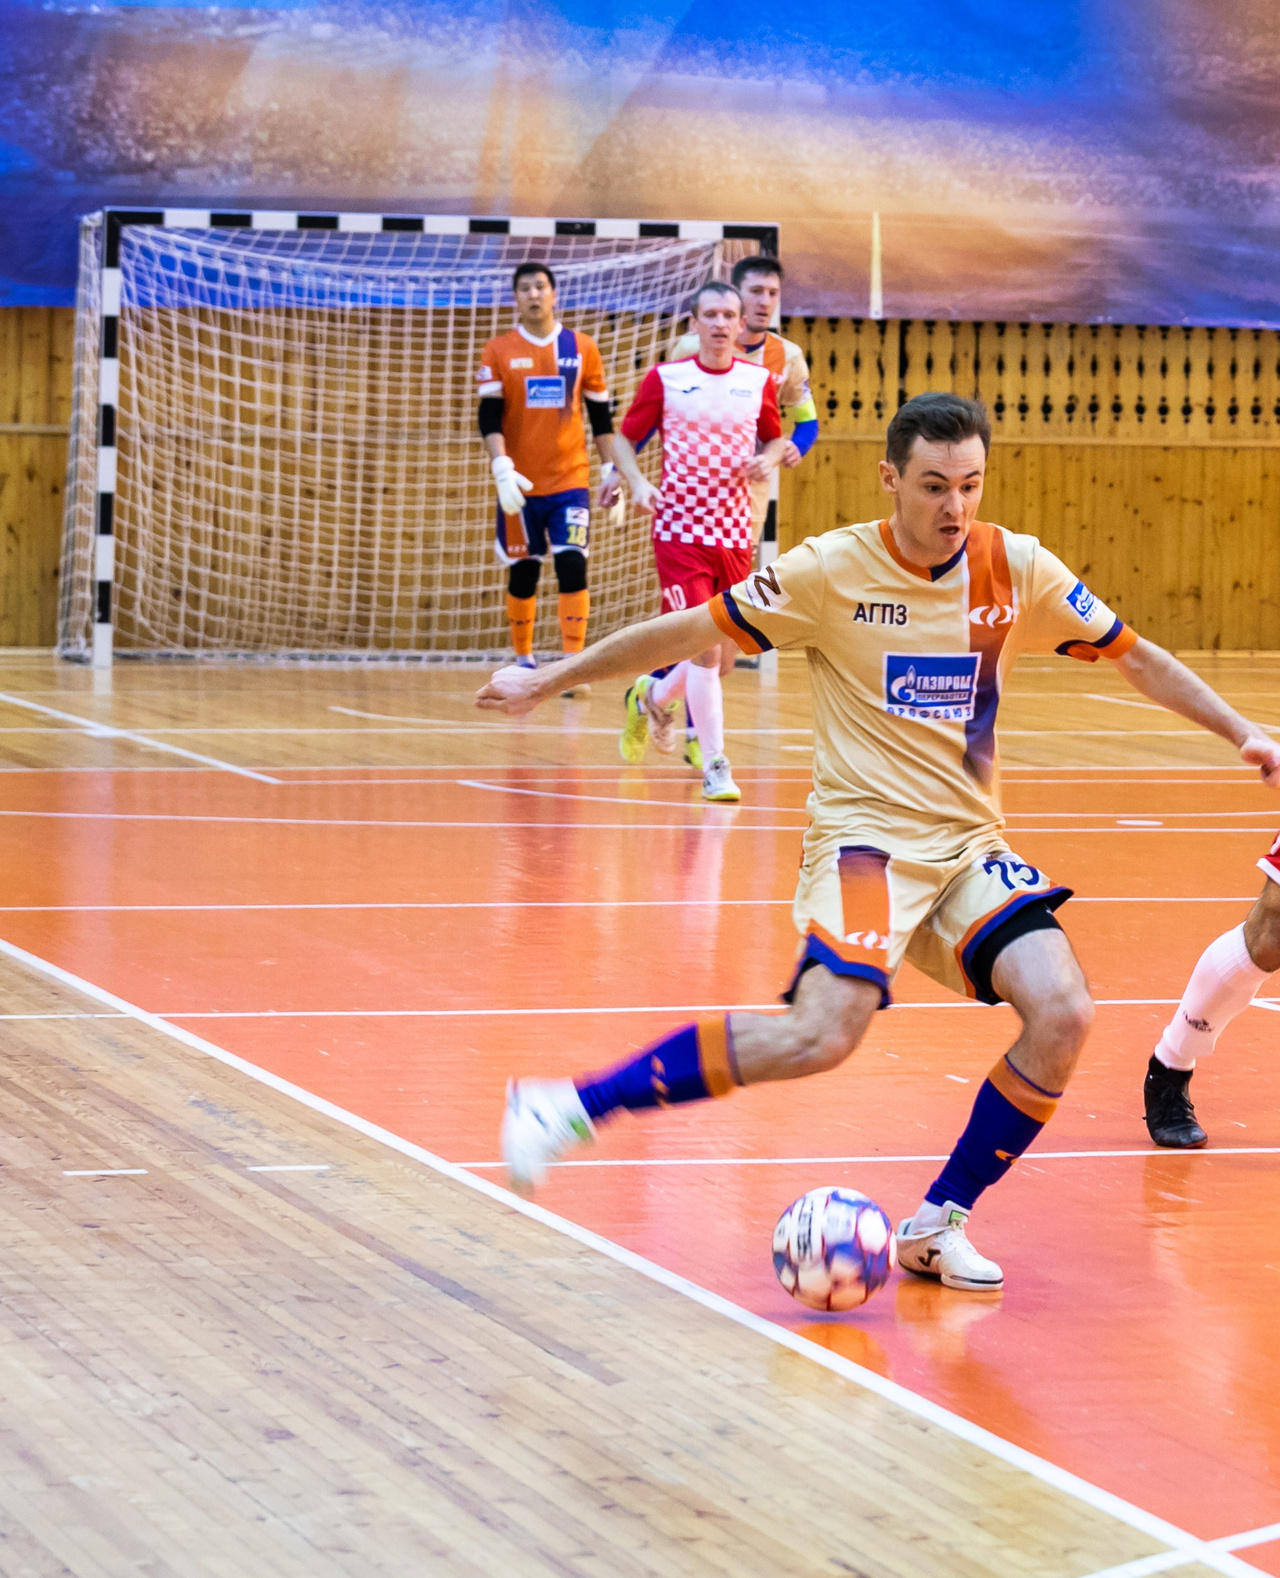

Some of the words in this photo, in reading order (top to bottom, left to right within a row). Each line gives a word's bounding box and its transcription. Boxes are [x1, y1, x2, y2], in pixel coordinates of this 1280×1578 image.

[664, 584, 687, 610] 10
[852, 602, 908, 626] АГПЗ
[916, 675, 972, 691] ГАЗПРОМ
[982, 859, 1040, 891] 75
